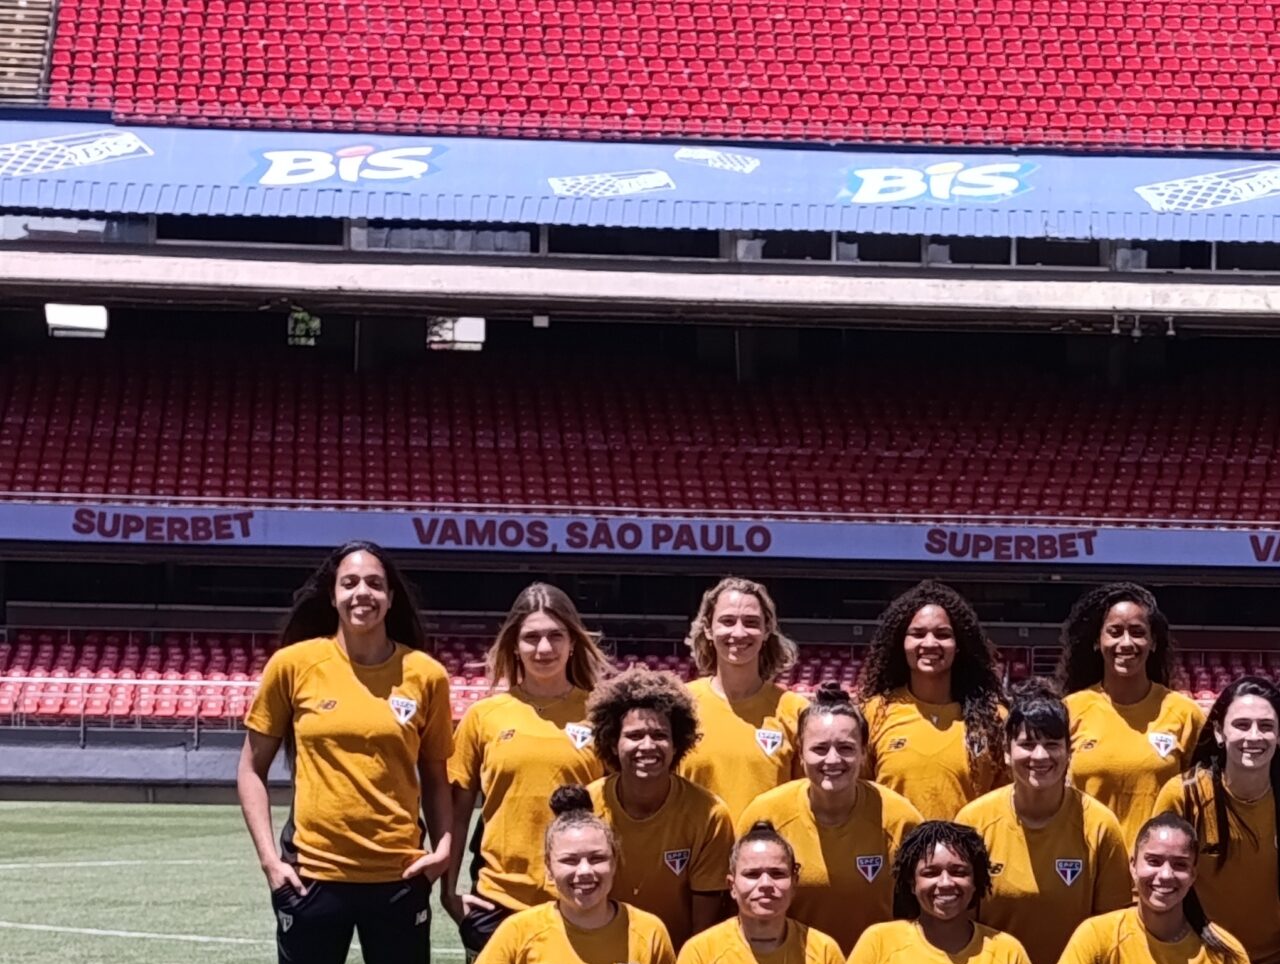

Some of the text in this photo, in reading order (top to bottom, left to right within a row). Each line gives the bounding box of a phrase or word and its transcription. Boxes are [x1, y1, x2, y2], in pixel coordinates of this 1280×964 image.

[72, 508, 254, 541] SUPERBET
[412, 517, 772, 552] VAMOS, SÃO PAULO
[925, 528, 1098, 560] SUPERBET
